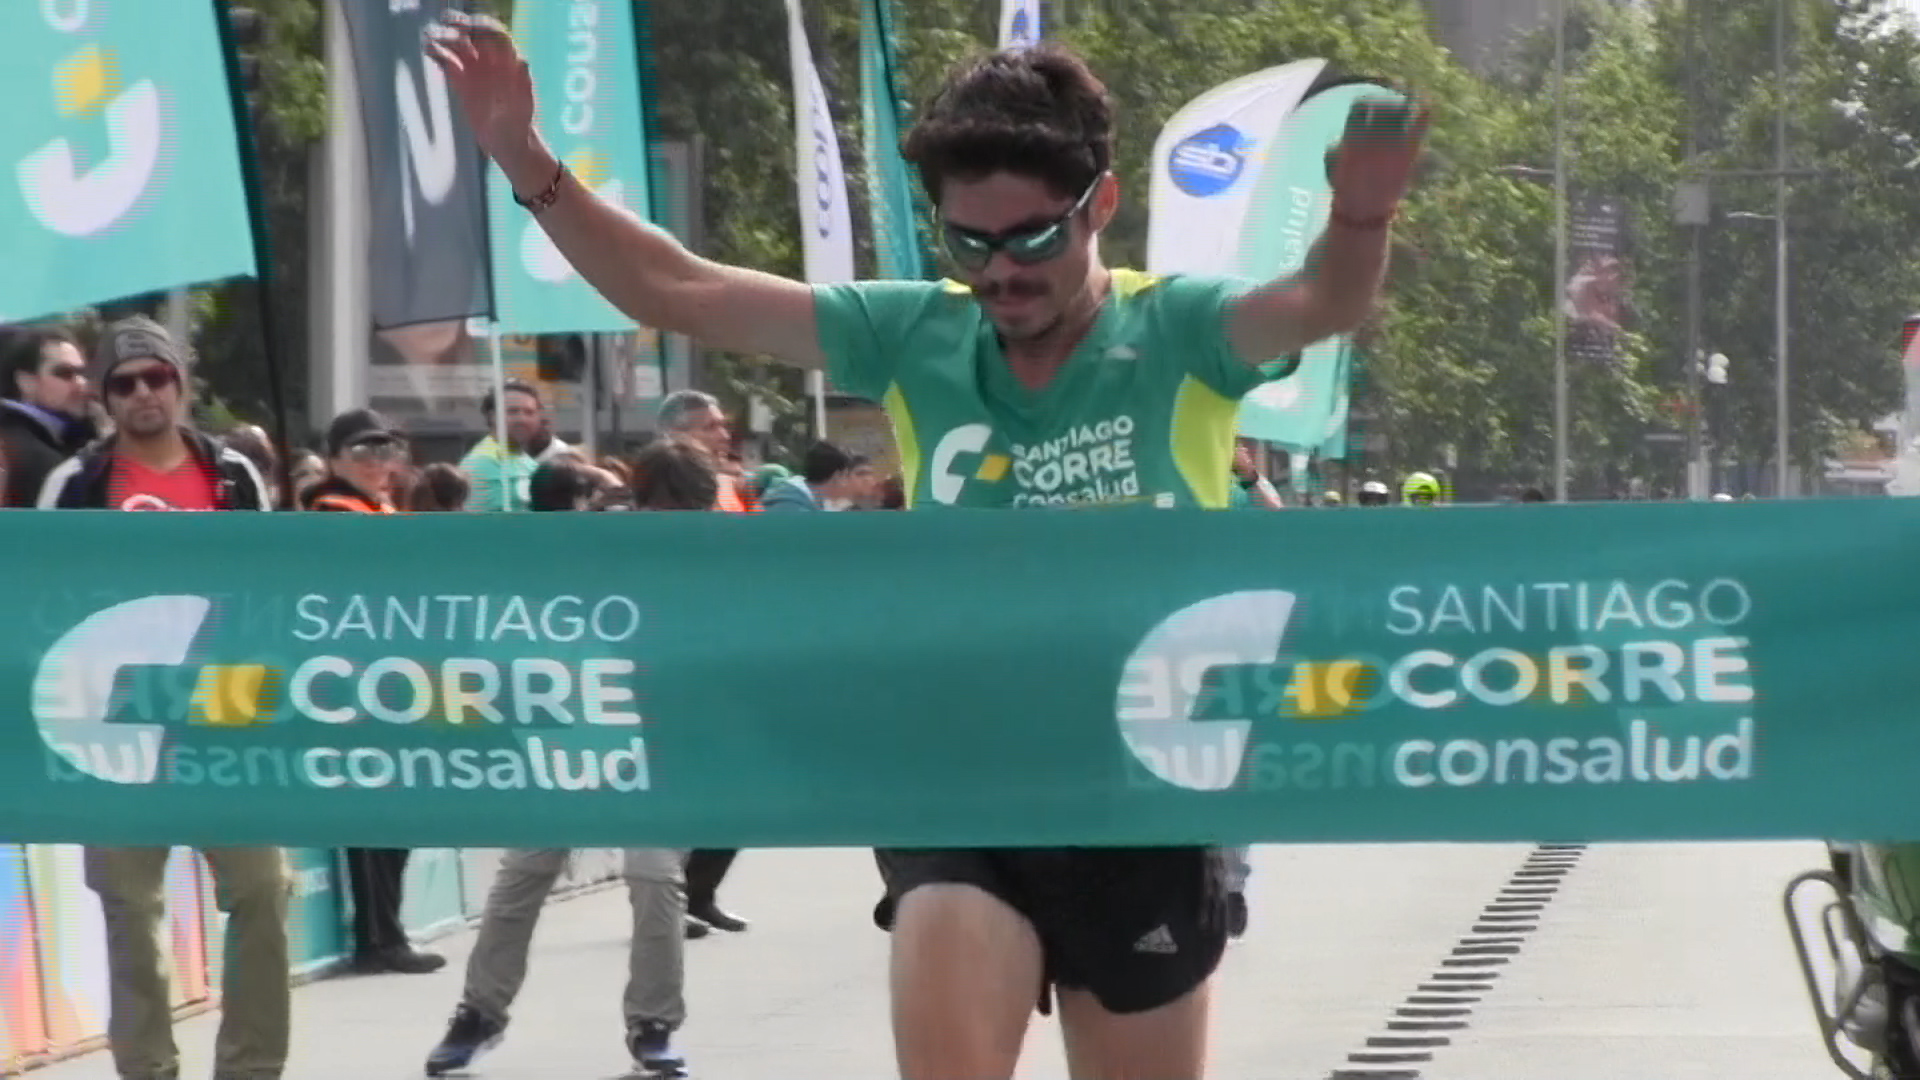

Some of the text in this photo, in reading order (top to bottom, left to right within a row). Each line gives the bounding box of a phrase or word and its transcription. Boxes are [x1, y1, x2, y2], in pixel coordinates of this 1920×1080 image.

[1009, 415, 1134, 463] SANTIAGO
[1013, 438, 1135, 491] CORRE
[293, 594, 640, 642] SANTIAGO
[1386, 577, 1752, 635] SANTIAGO
[289, 655, 642, 724] CORRE
[1388, 636, 1755, 710] CORRE
[302, 736, 651, 791] consalud
[1393, 718, 1754, 787] consalud
